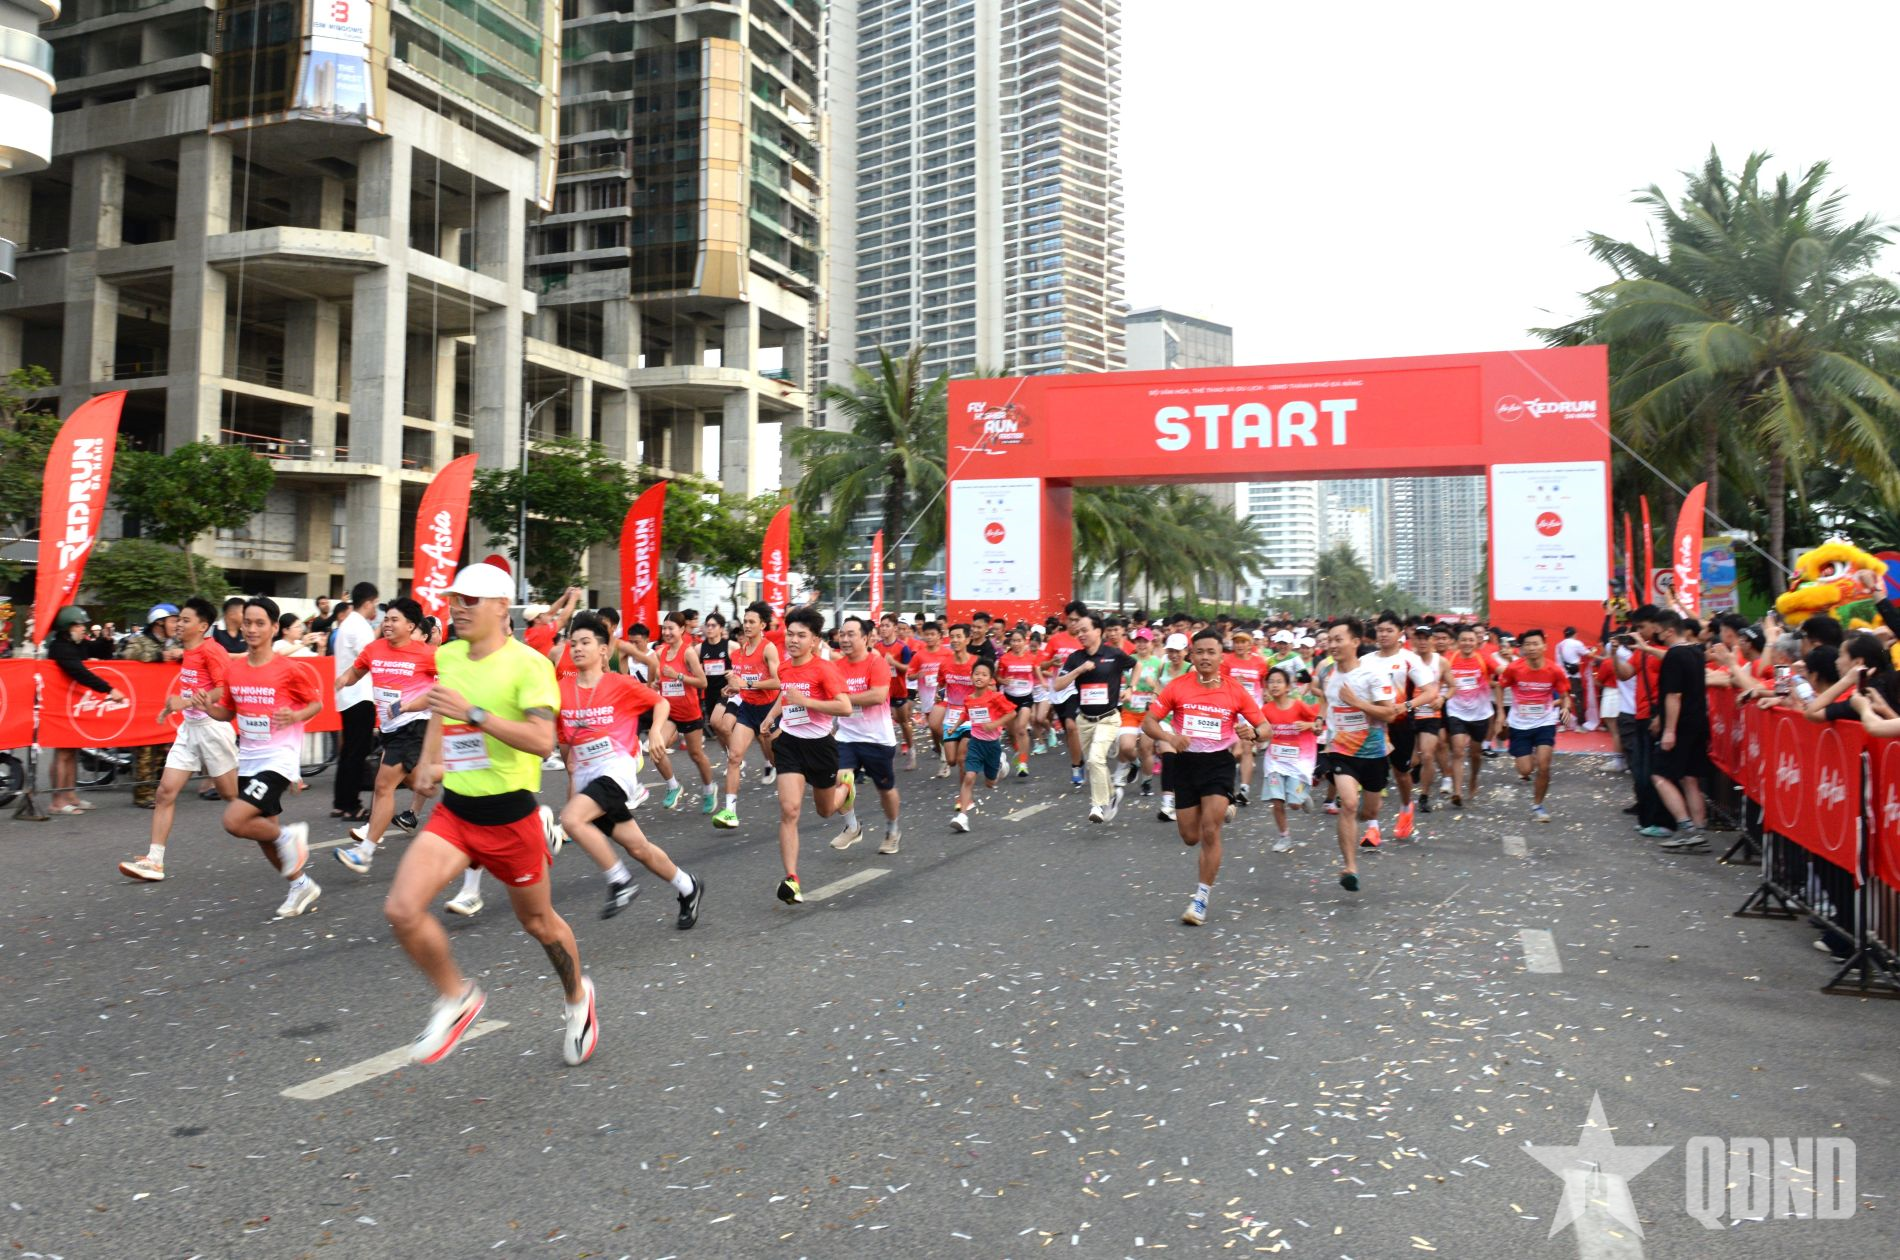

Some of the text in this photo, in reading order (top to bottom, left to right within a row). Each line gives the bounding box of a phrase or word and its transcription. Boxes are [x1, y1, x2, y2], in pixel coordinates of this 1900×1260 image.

[967, 402, 987, 412] FLY
[984, 419, 1018, 433] RUN
[1154, 399, 1358, 451] START
[240, 685, 276, 697] HIGHER
